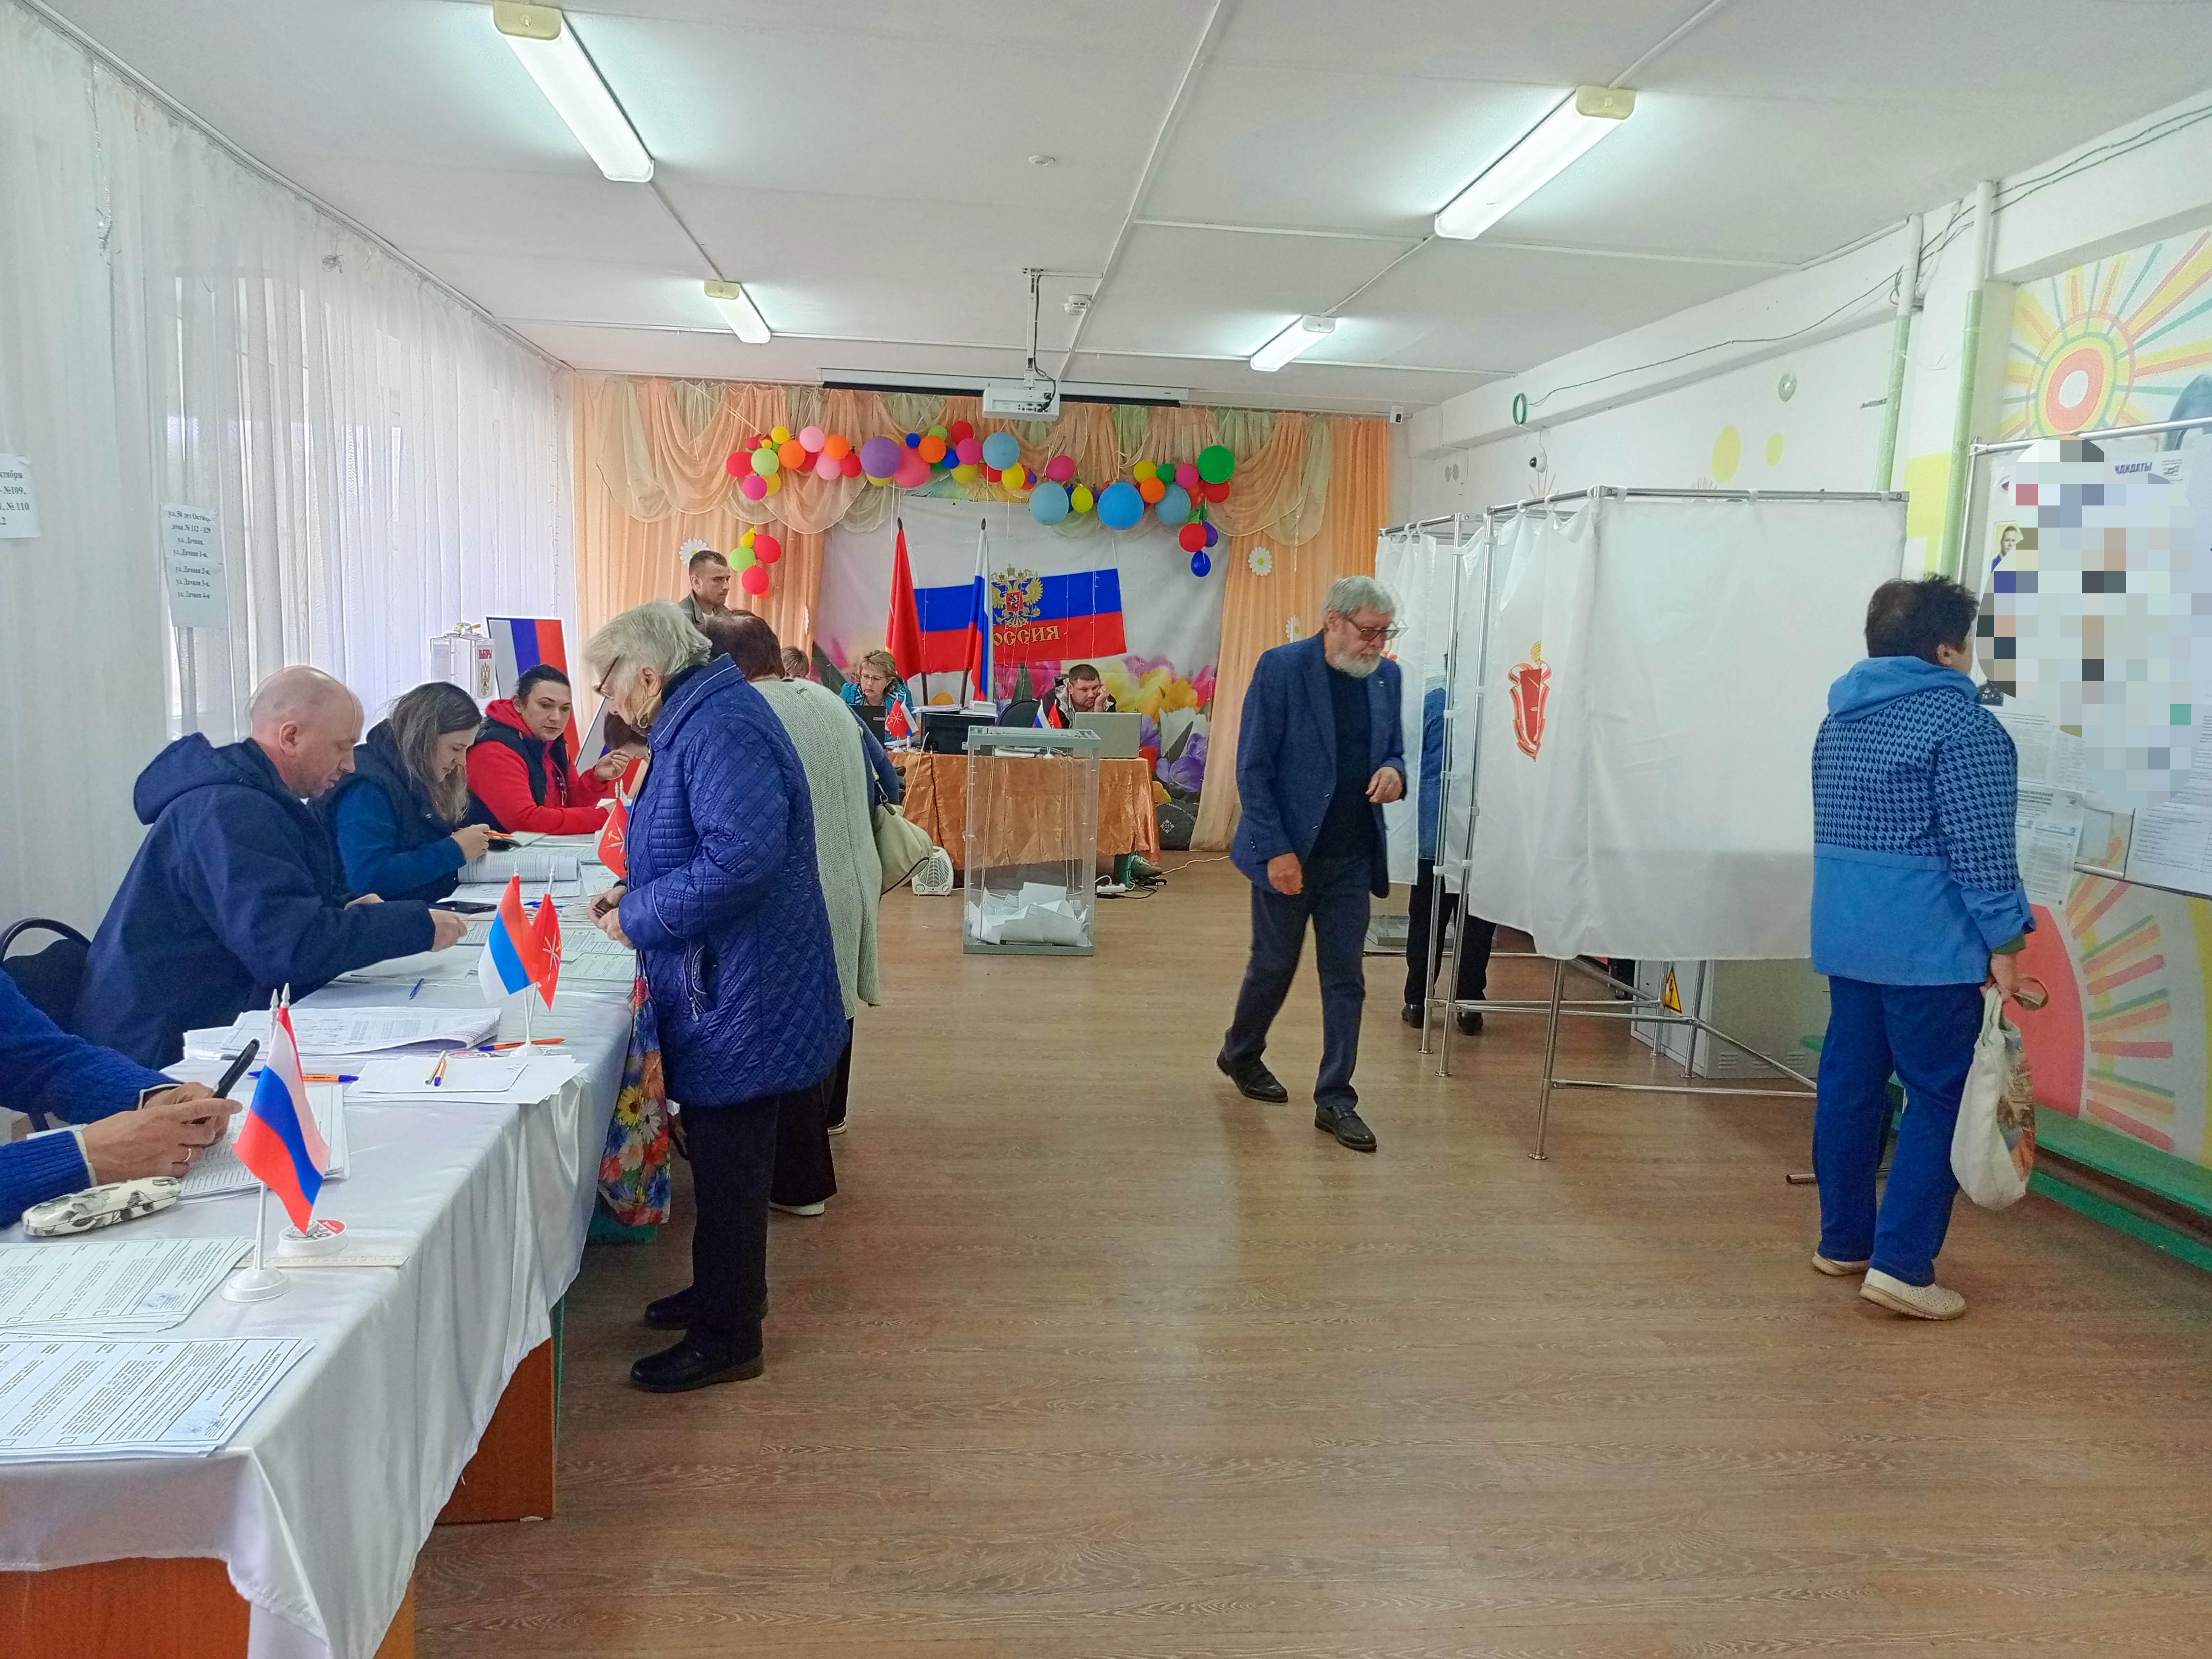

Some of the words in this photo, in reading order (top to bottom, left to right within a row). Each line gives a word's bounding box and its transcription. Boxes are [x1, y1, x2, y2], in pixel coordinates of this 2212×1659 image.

[2114, 462, 2152, 474] НДИДАТЫ
[16, 502, 29, 511] 110
[993, 625, 1060, 646] ОССИЯ
